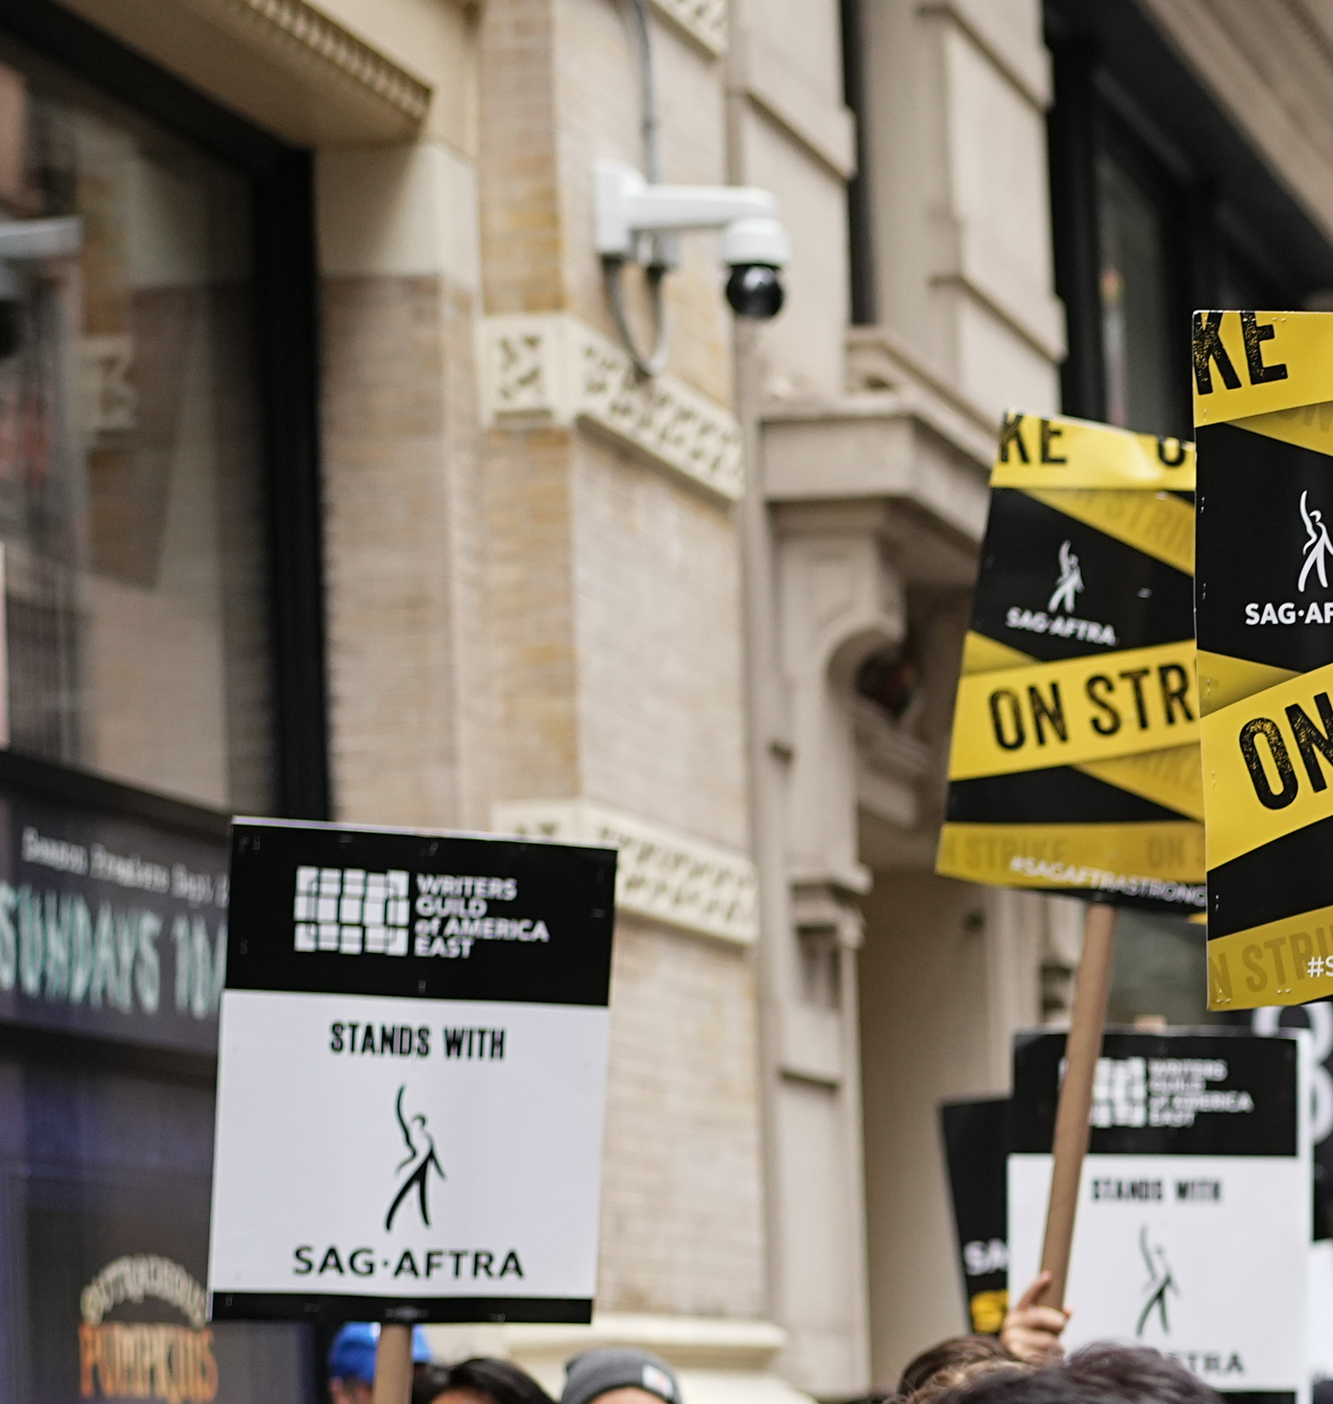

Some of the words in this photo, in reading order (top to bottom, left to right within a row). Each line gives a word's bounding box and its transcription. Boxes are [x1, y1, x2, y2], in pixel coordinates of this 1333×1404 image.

[987, 682, 1069, 753] ON
[415, 872, 518, 901] WRITERS
[414, 896, 488, 919] GUILD
[413, 918, 441, 938] of
[443, 917, 550, 943] AMERICA
[413, 936, 475, 959] EAST
[329, 1021, 431, 1058] STANDS
[443, 1026, 506, 1061] WITH
[1174, 1177, 1223, 1203] WITH
